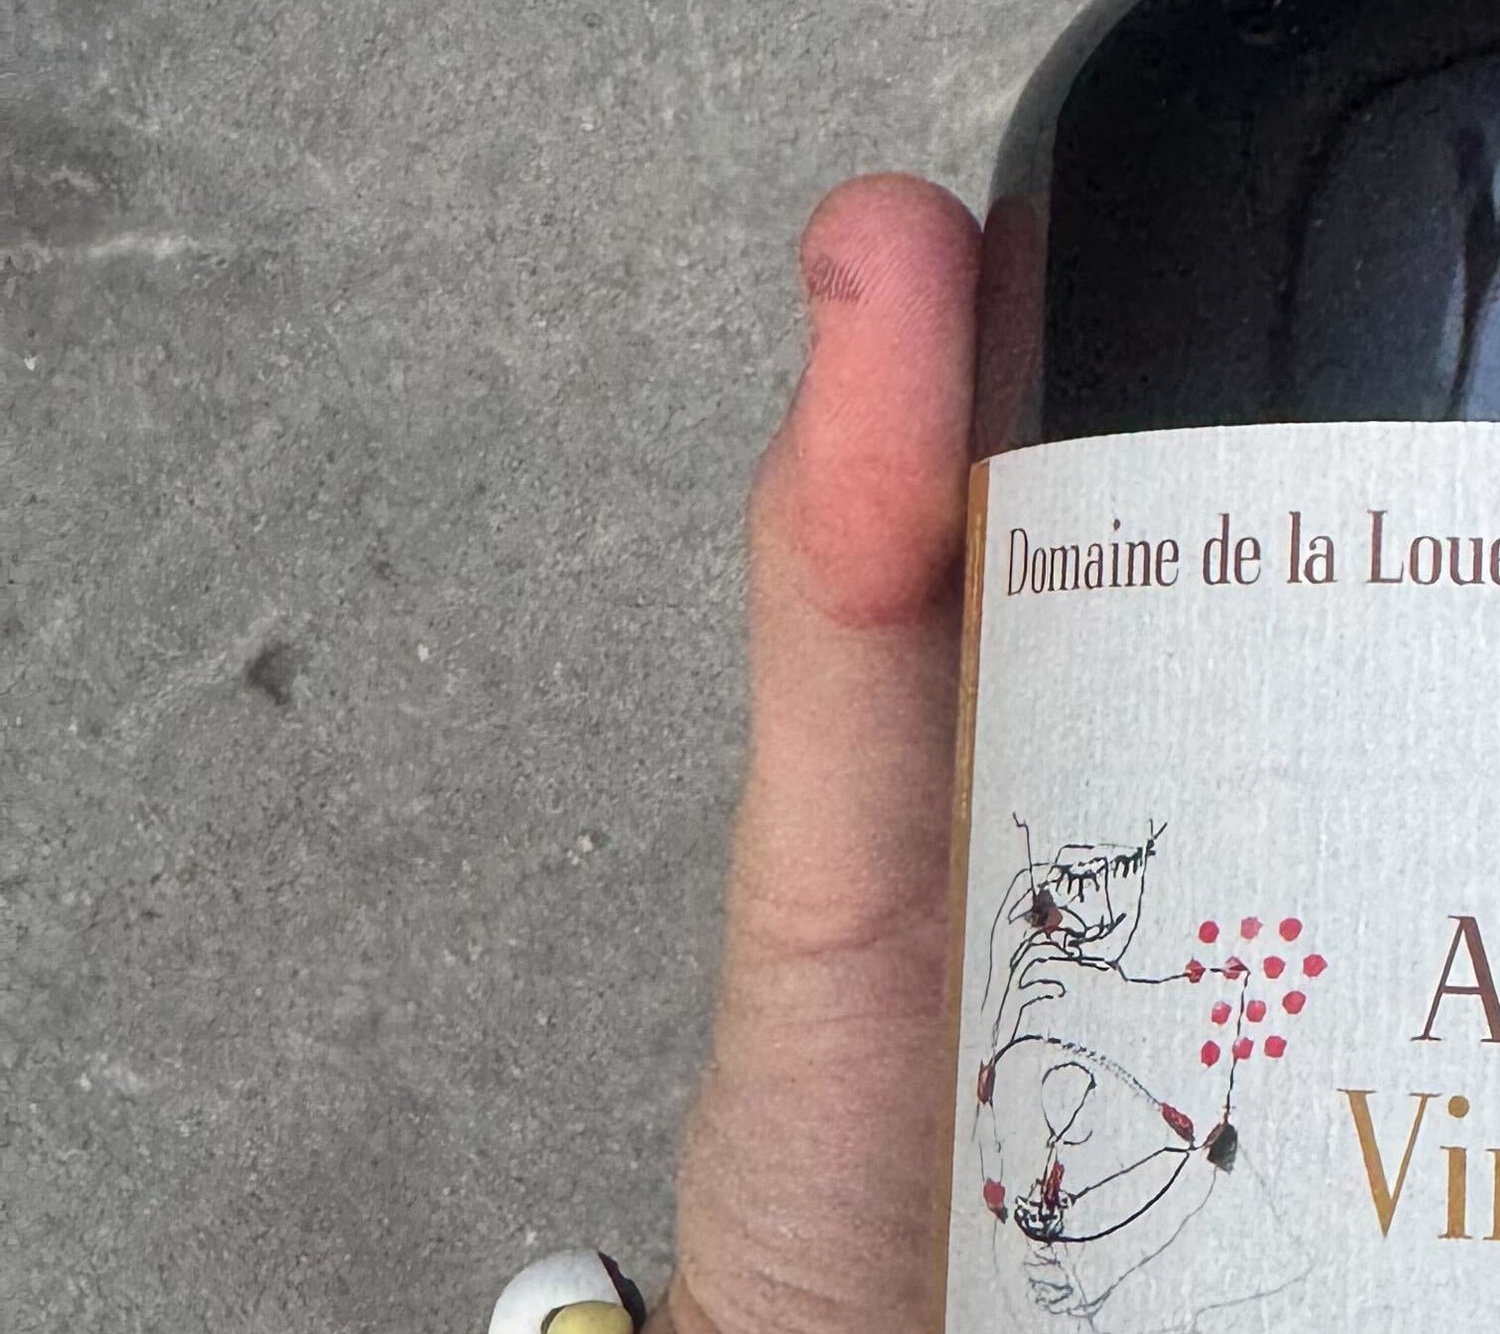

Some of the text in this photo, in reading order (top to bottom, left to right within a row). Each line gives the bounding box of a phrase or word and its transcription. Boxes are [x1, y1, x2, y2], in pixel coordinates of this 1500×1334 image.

[1008, 519, 1179, 595] Domaine
[1203, 513, 1261, 585] de
[1287, 511, 1337, 584] la
